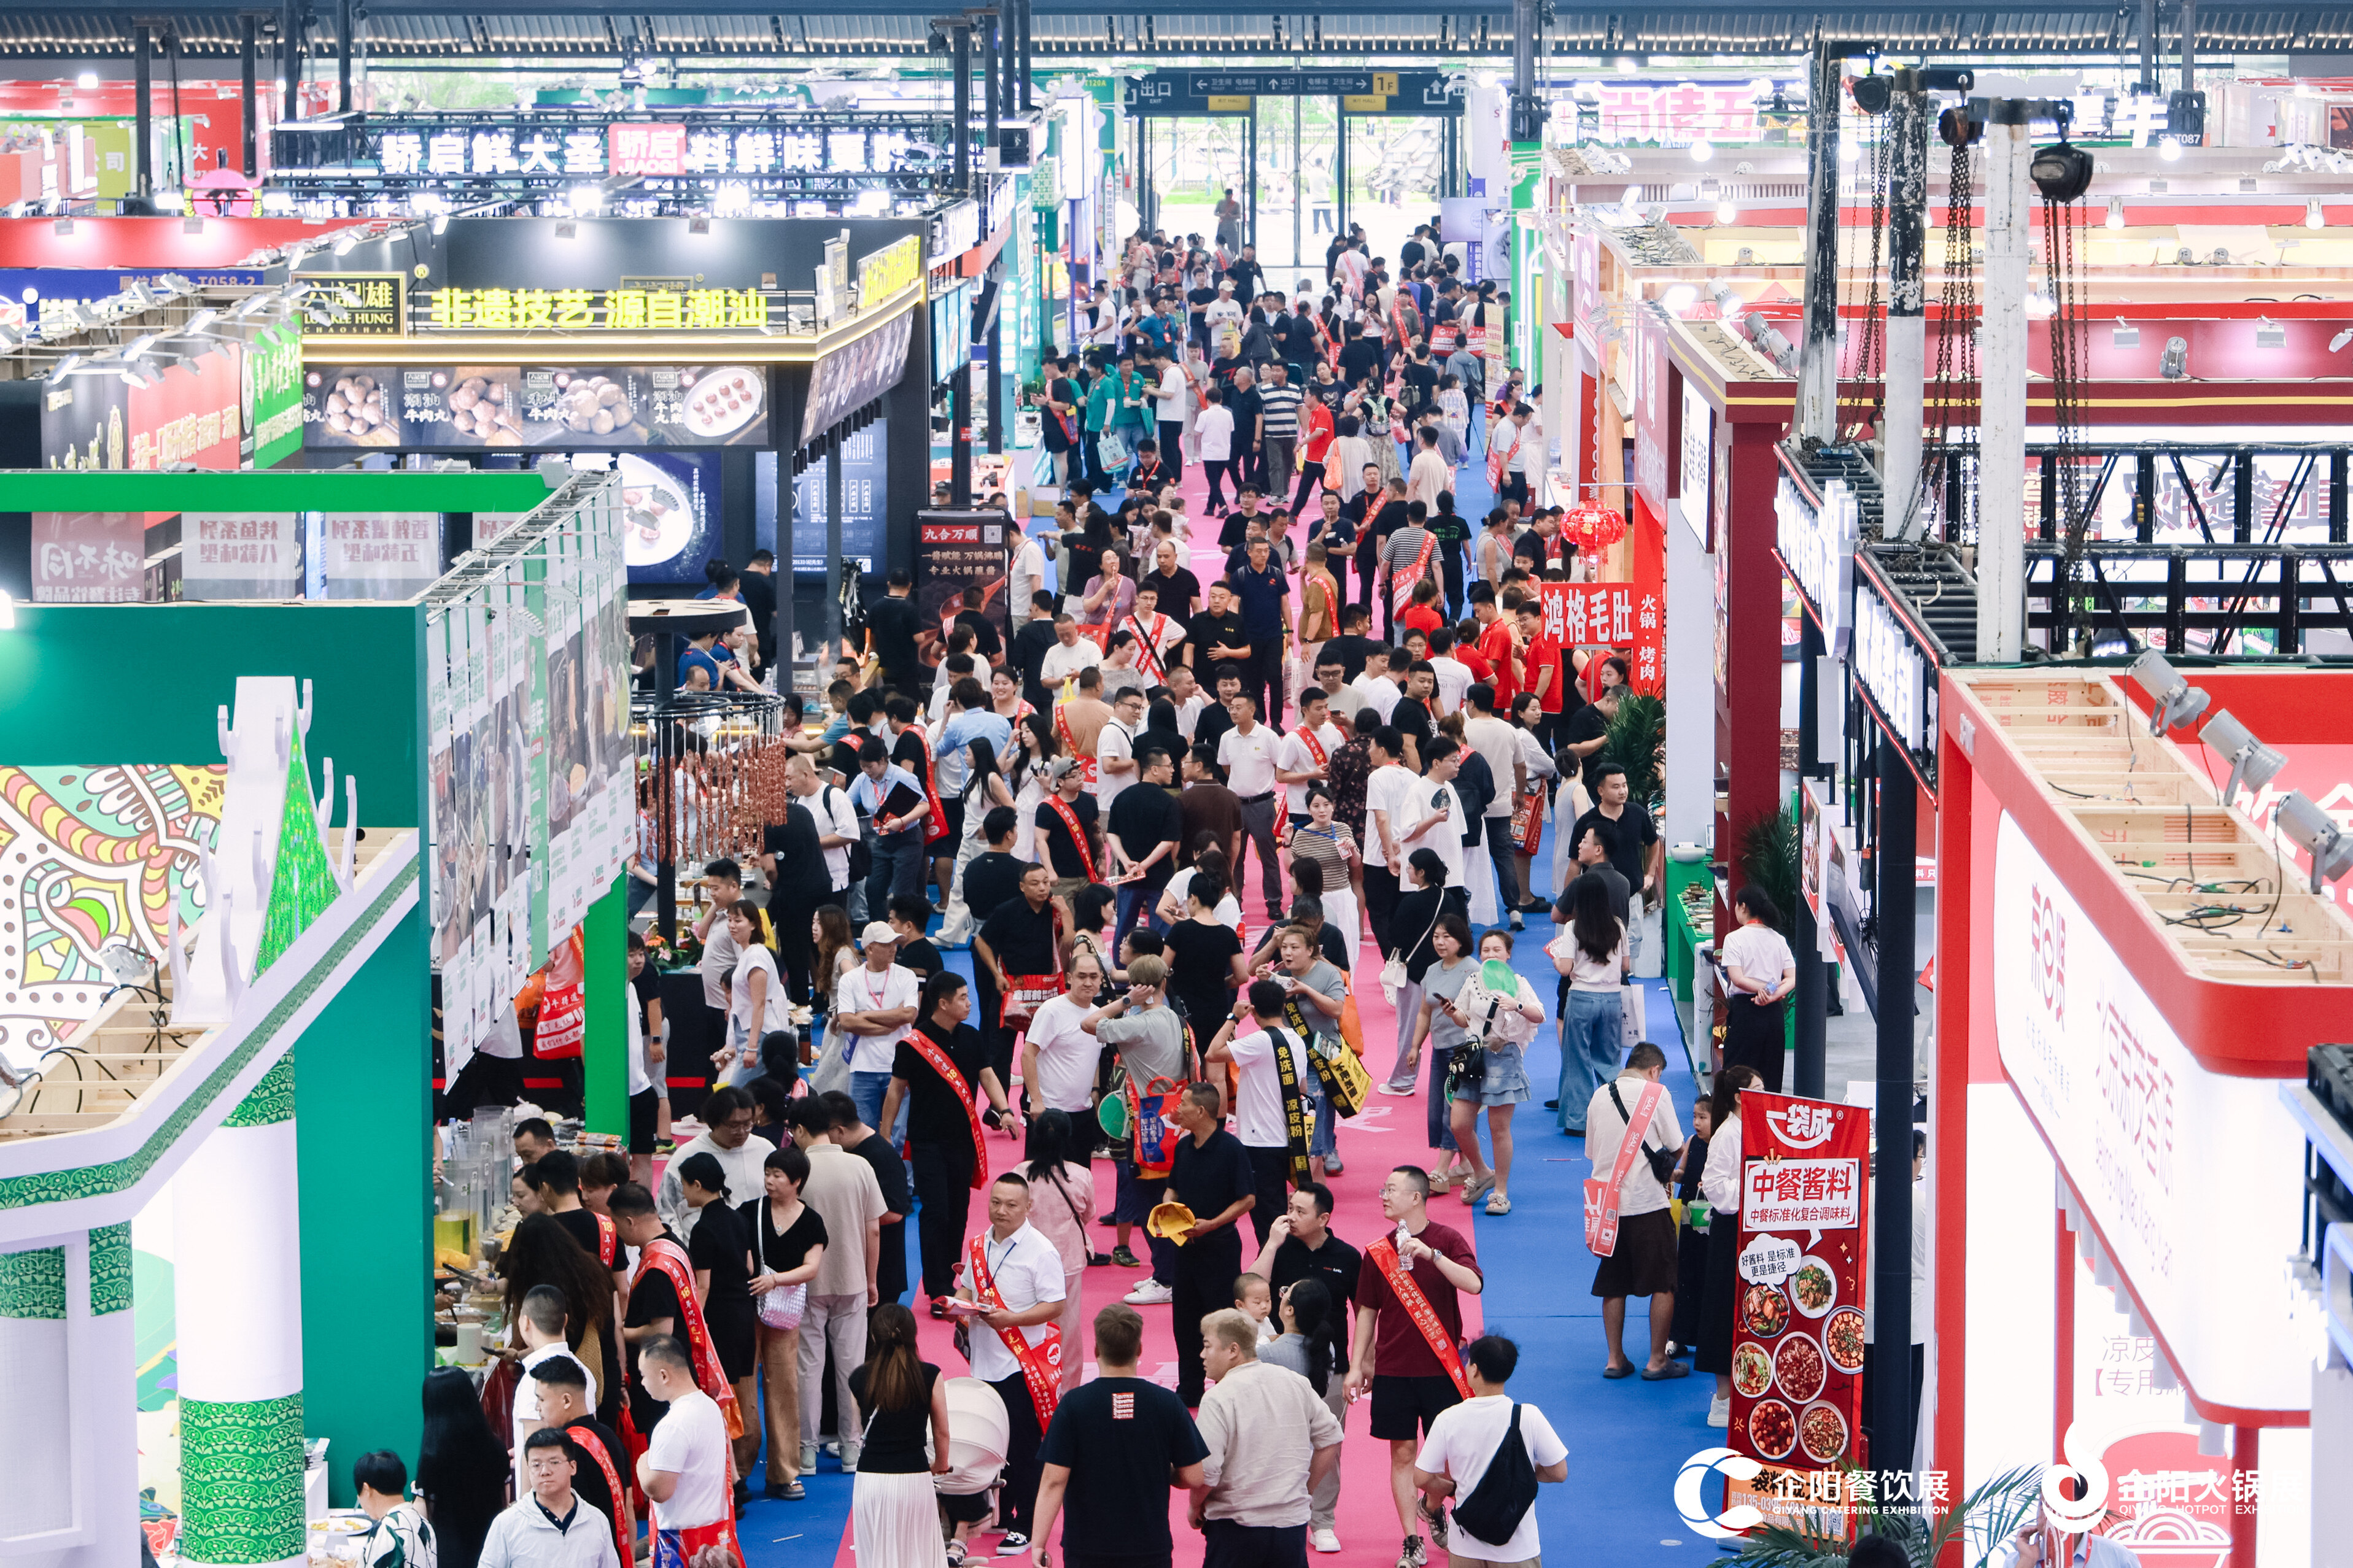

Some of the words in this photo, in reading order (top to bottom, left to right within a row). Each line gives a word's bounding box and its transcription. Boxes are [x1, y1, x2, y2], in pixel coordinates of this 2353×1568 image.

[1141, 80, 1171, 96] 出口
[618, 129, 678, 159] 骄启
[618, 158, 678, 174] JIAOQI
[431, 288, 594, 329] 非遗技艺
[604, 287, 767, 329] 源自潮汕
[355, 313, 393, 324] HUNG
[404, 409, 450, 423] 牛肉丸
[528, 407, 572, 422] 牛肉丸
[653, 402, 683, 414] 牛肉
[924, 528, 979, 541] 九合万顺
[1543, 588, 1634, 644] 鸿格毛肚
[551, 992, 580, 1008] 牛得道
[1276, 1046, 1295, 1086] 免洗面
[1285, 1099, 1303, 1138] 凉皮粉
[1766, 1103, 1835, 1149] 一袋成
[1753, 1166, 1852, 1203] 中餐酱料
[1750, 1206, 1850, 1223] 中餐标准化复合调味料
[1742, 1252, 1764, 1267] 好酱料
[1767, 1246, 1796, 1262] 是标准
[1751, 1262, 1787, 1278] 更是捷径
